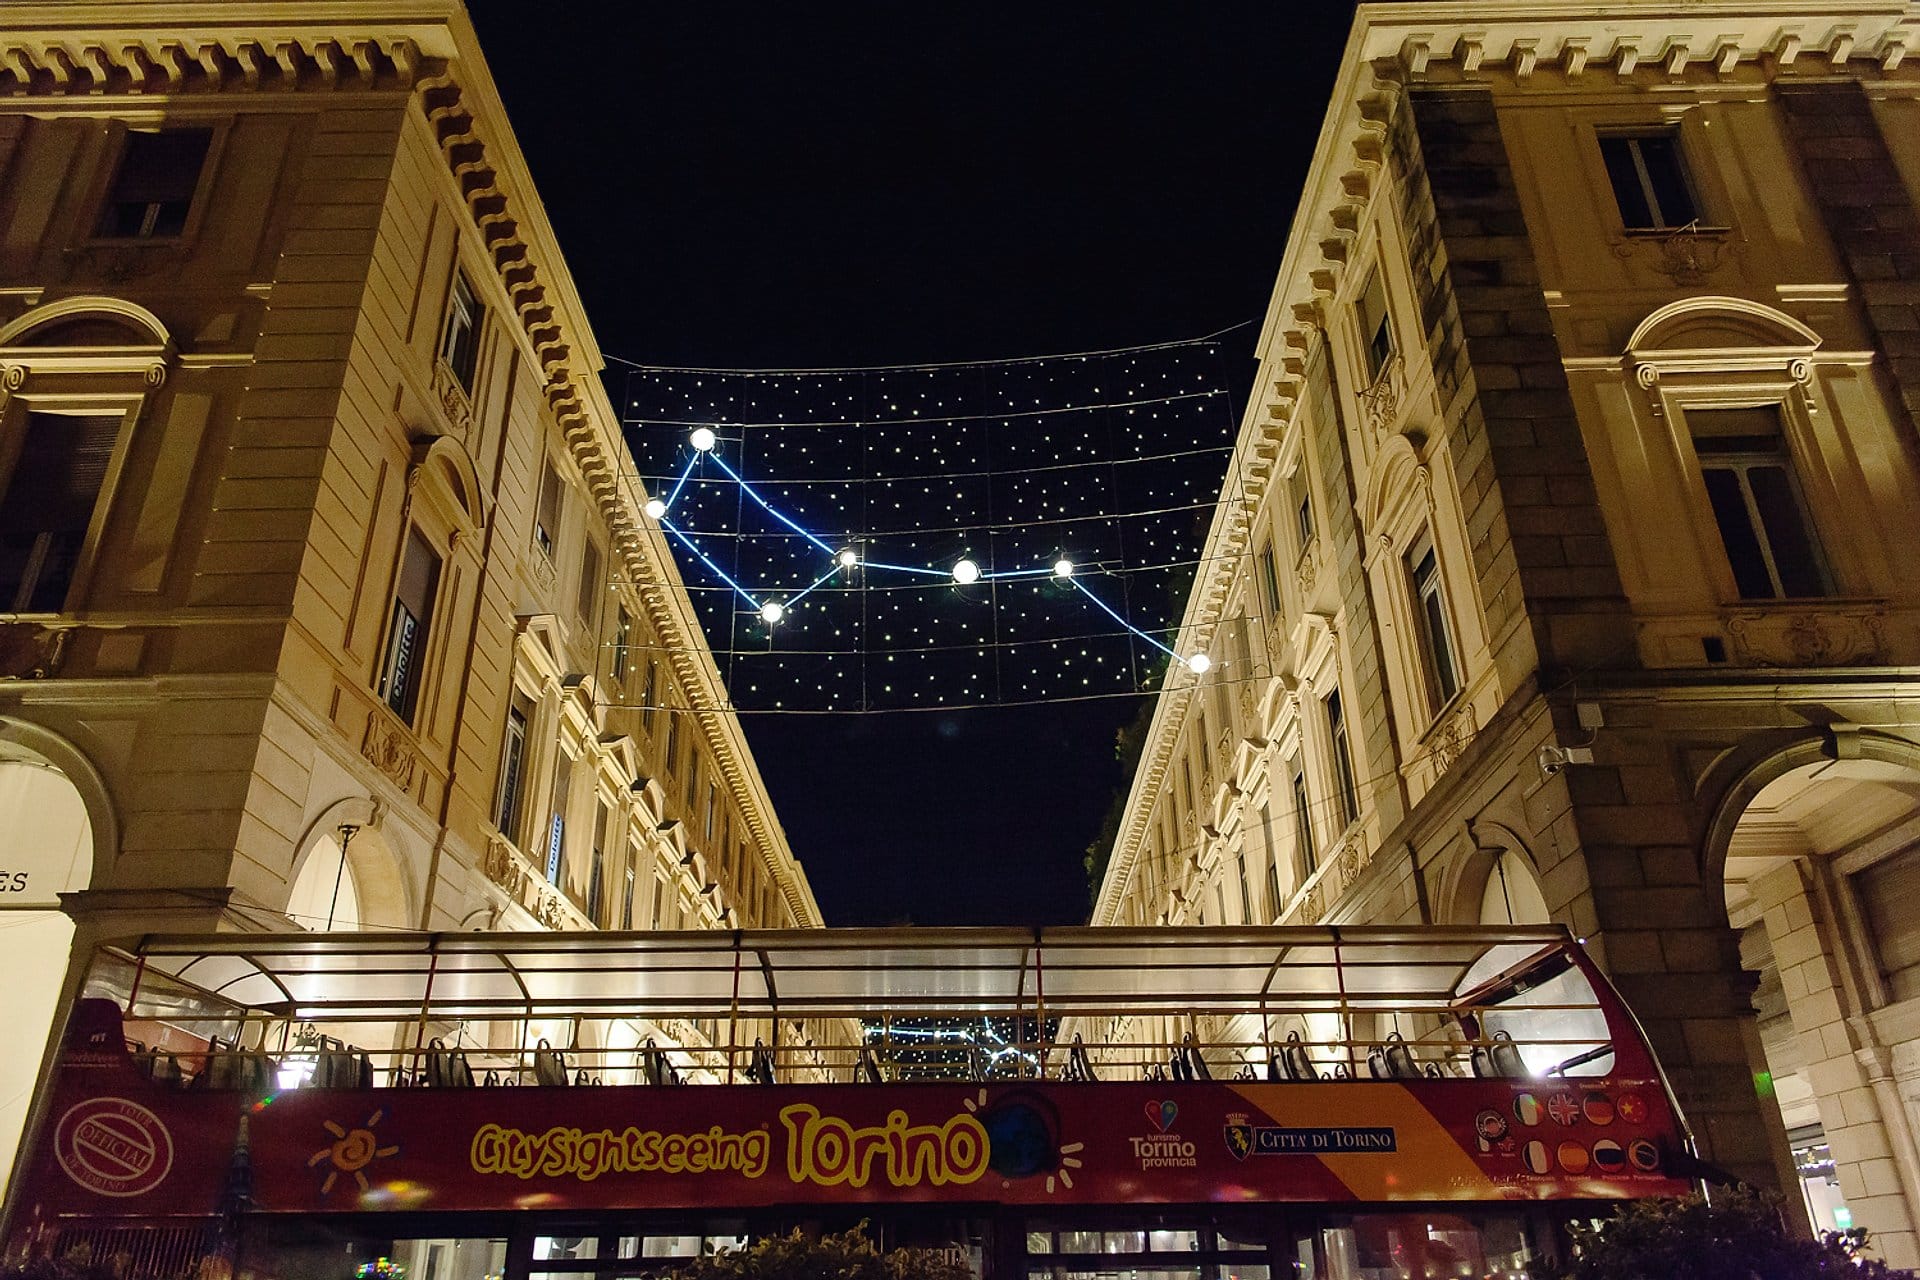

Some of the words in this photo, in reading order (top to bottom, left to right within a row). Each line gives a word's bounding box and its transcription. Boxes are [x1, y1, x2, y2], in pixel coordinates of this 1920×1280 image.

[549, 815, 562, 872] Deloitte
[80, 1122, 149, 1168] OFFICIAL
[470, 1122, 771, 1182] CitySightseeing
[779, 1102, 991, 1188] Torino
[1128, 1136, 1197, 1158] Torino
[1331, 1129, 1392, 1148] TORINO
[1141, 1157, 1197, 1171] provincia
